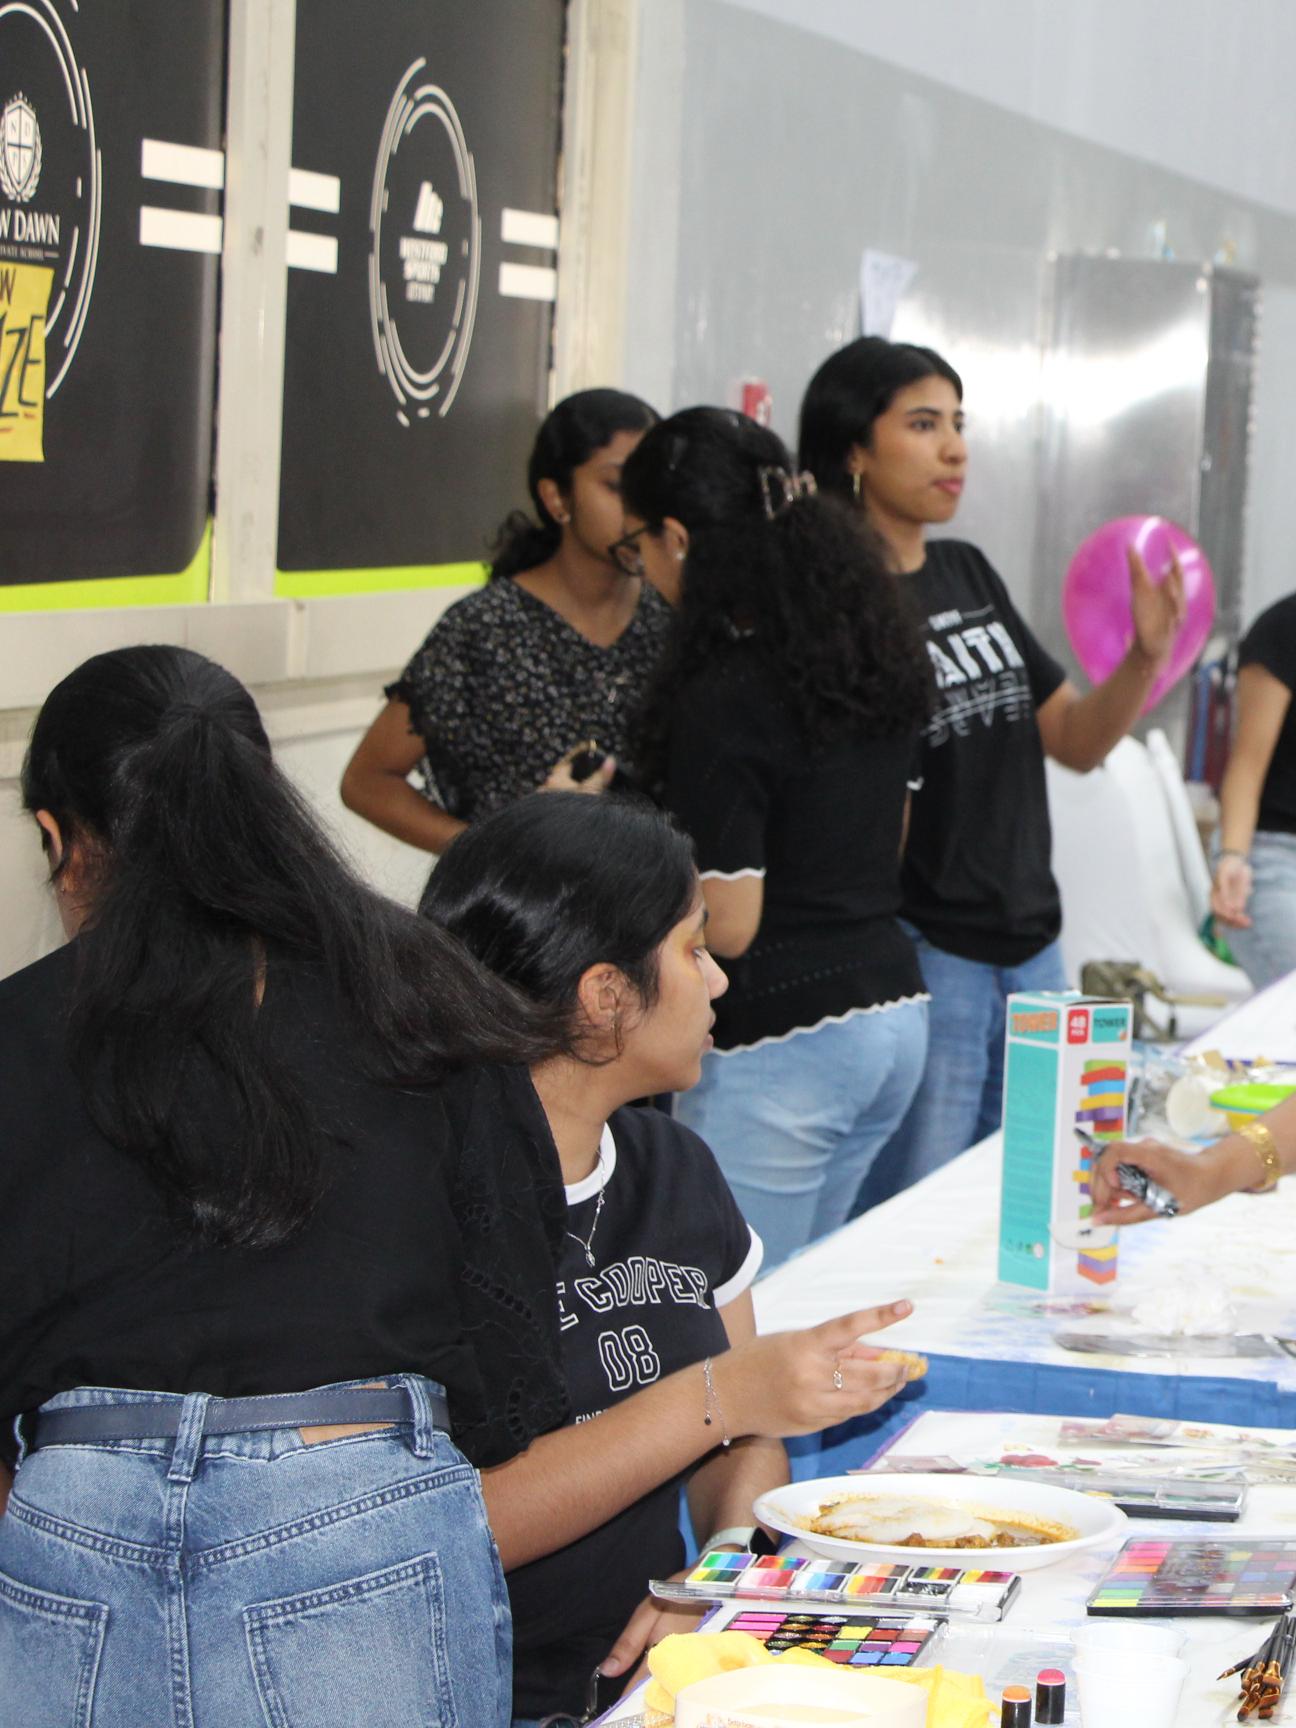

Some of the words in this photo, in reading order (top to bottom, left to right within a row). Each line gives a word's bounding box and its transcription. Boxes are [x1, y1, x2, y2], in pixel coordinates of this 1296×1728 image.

[14, 208, 60, 246] DAWN
[573, 1256, 713, 1313] COOPER
[597, 1324, 661, 1392] 08
